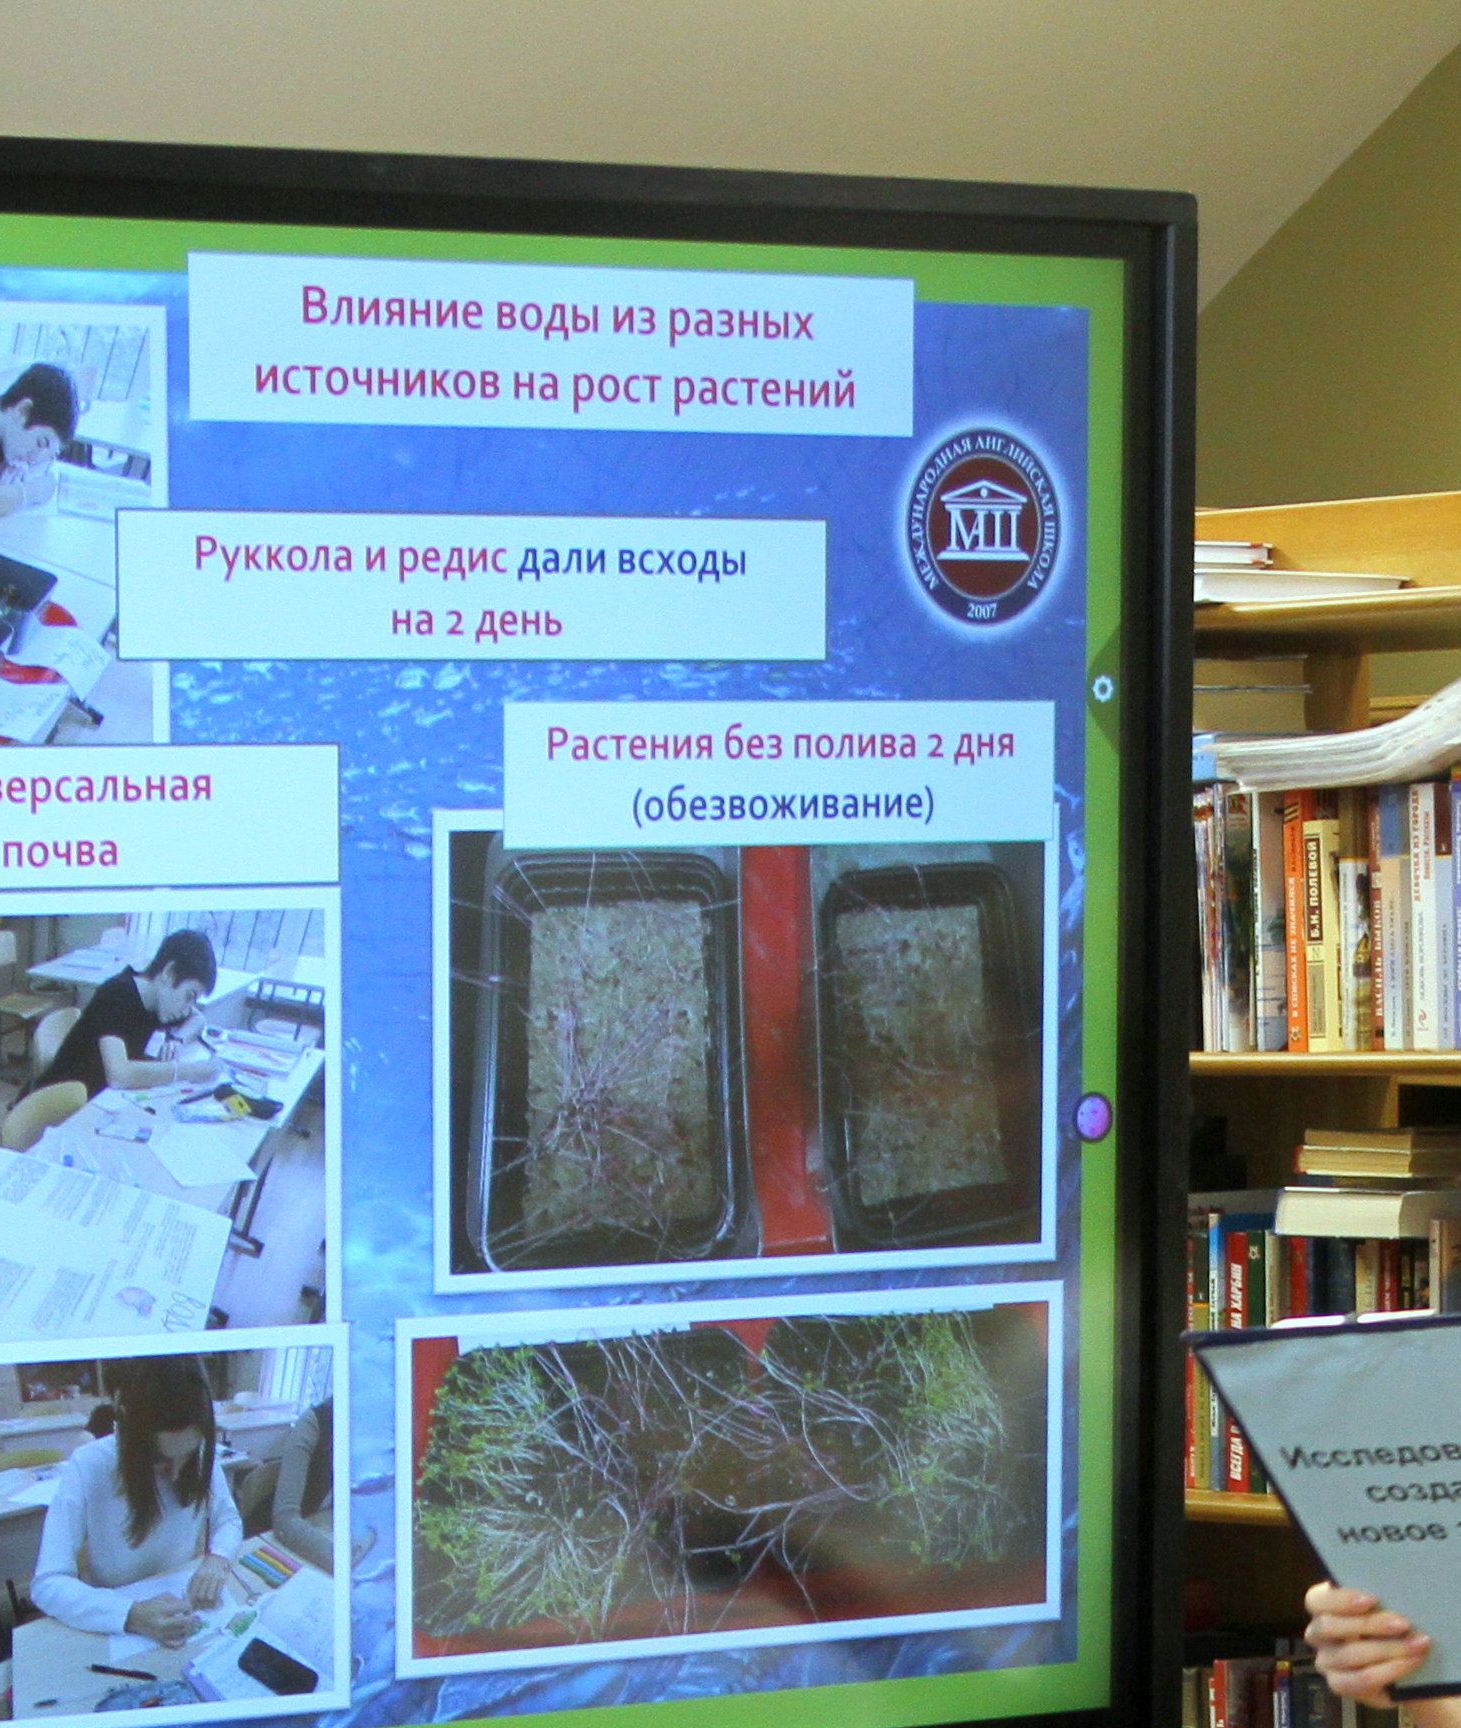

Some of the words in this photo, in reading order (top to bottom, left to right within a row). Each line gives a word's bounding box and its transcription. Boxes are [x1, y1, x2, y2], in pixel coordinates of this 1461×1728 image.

[303, 286, 482, 329] Влияние
[498, 302, 598, 340] воды
[614, 306, 655, 335] из
[670, 308, 813, 347] разных
[256, 365, 499, 398] источников
[514, 372, 558, 400] на
[574, 374, 661, 413] рост
[675, 370, 854, 415] растений
[910, 436, 971, 590] МЕЖДУНАРОДНАЯ
[975, 435, 1056, 517] АНГЛИЙСКАЯ
[1026, 521, 1056, 590] ШКОЛА
[196, 536, 351, 581] Руккола
[366, 547, 385, 571] и
[400, 547, 506, 582] редис
[518, 549, 605, 581] дали
[619, 550, 745, 582] всходы
[393, 610, 433, 635] на
[447, 611, 464, 635] 2
[476, 611, 562, 643] день
[966, 602, 998, 619] 2007
[548, 727, 712, 760] Растения
[725, 723, 782, 759] без
[795, 734, 915, 758] полива
[928, 734, 943, 757] 2
[954, 734, 1013, 765] дня
[634, 785, 933, 828] (обезвоживание)
[4, 841, 117, 867] почва
[1306, 840, 1319, 907] ПОЛЕВОЙ
[1308, 909, 1321, 938] Б.Н.
[1230, 1262, 1243, 1311] ХАРБИН
[1231, 1313, 1242, 1329] НА
[1230, 1437, 1243, 1481] ВСЕГДА
[1337, 1524, 1448, 1543] новое
